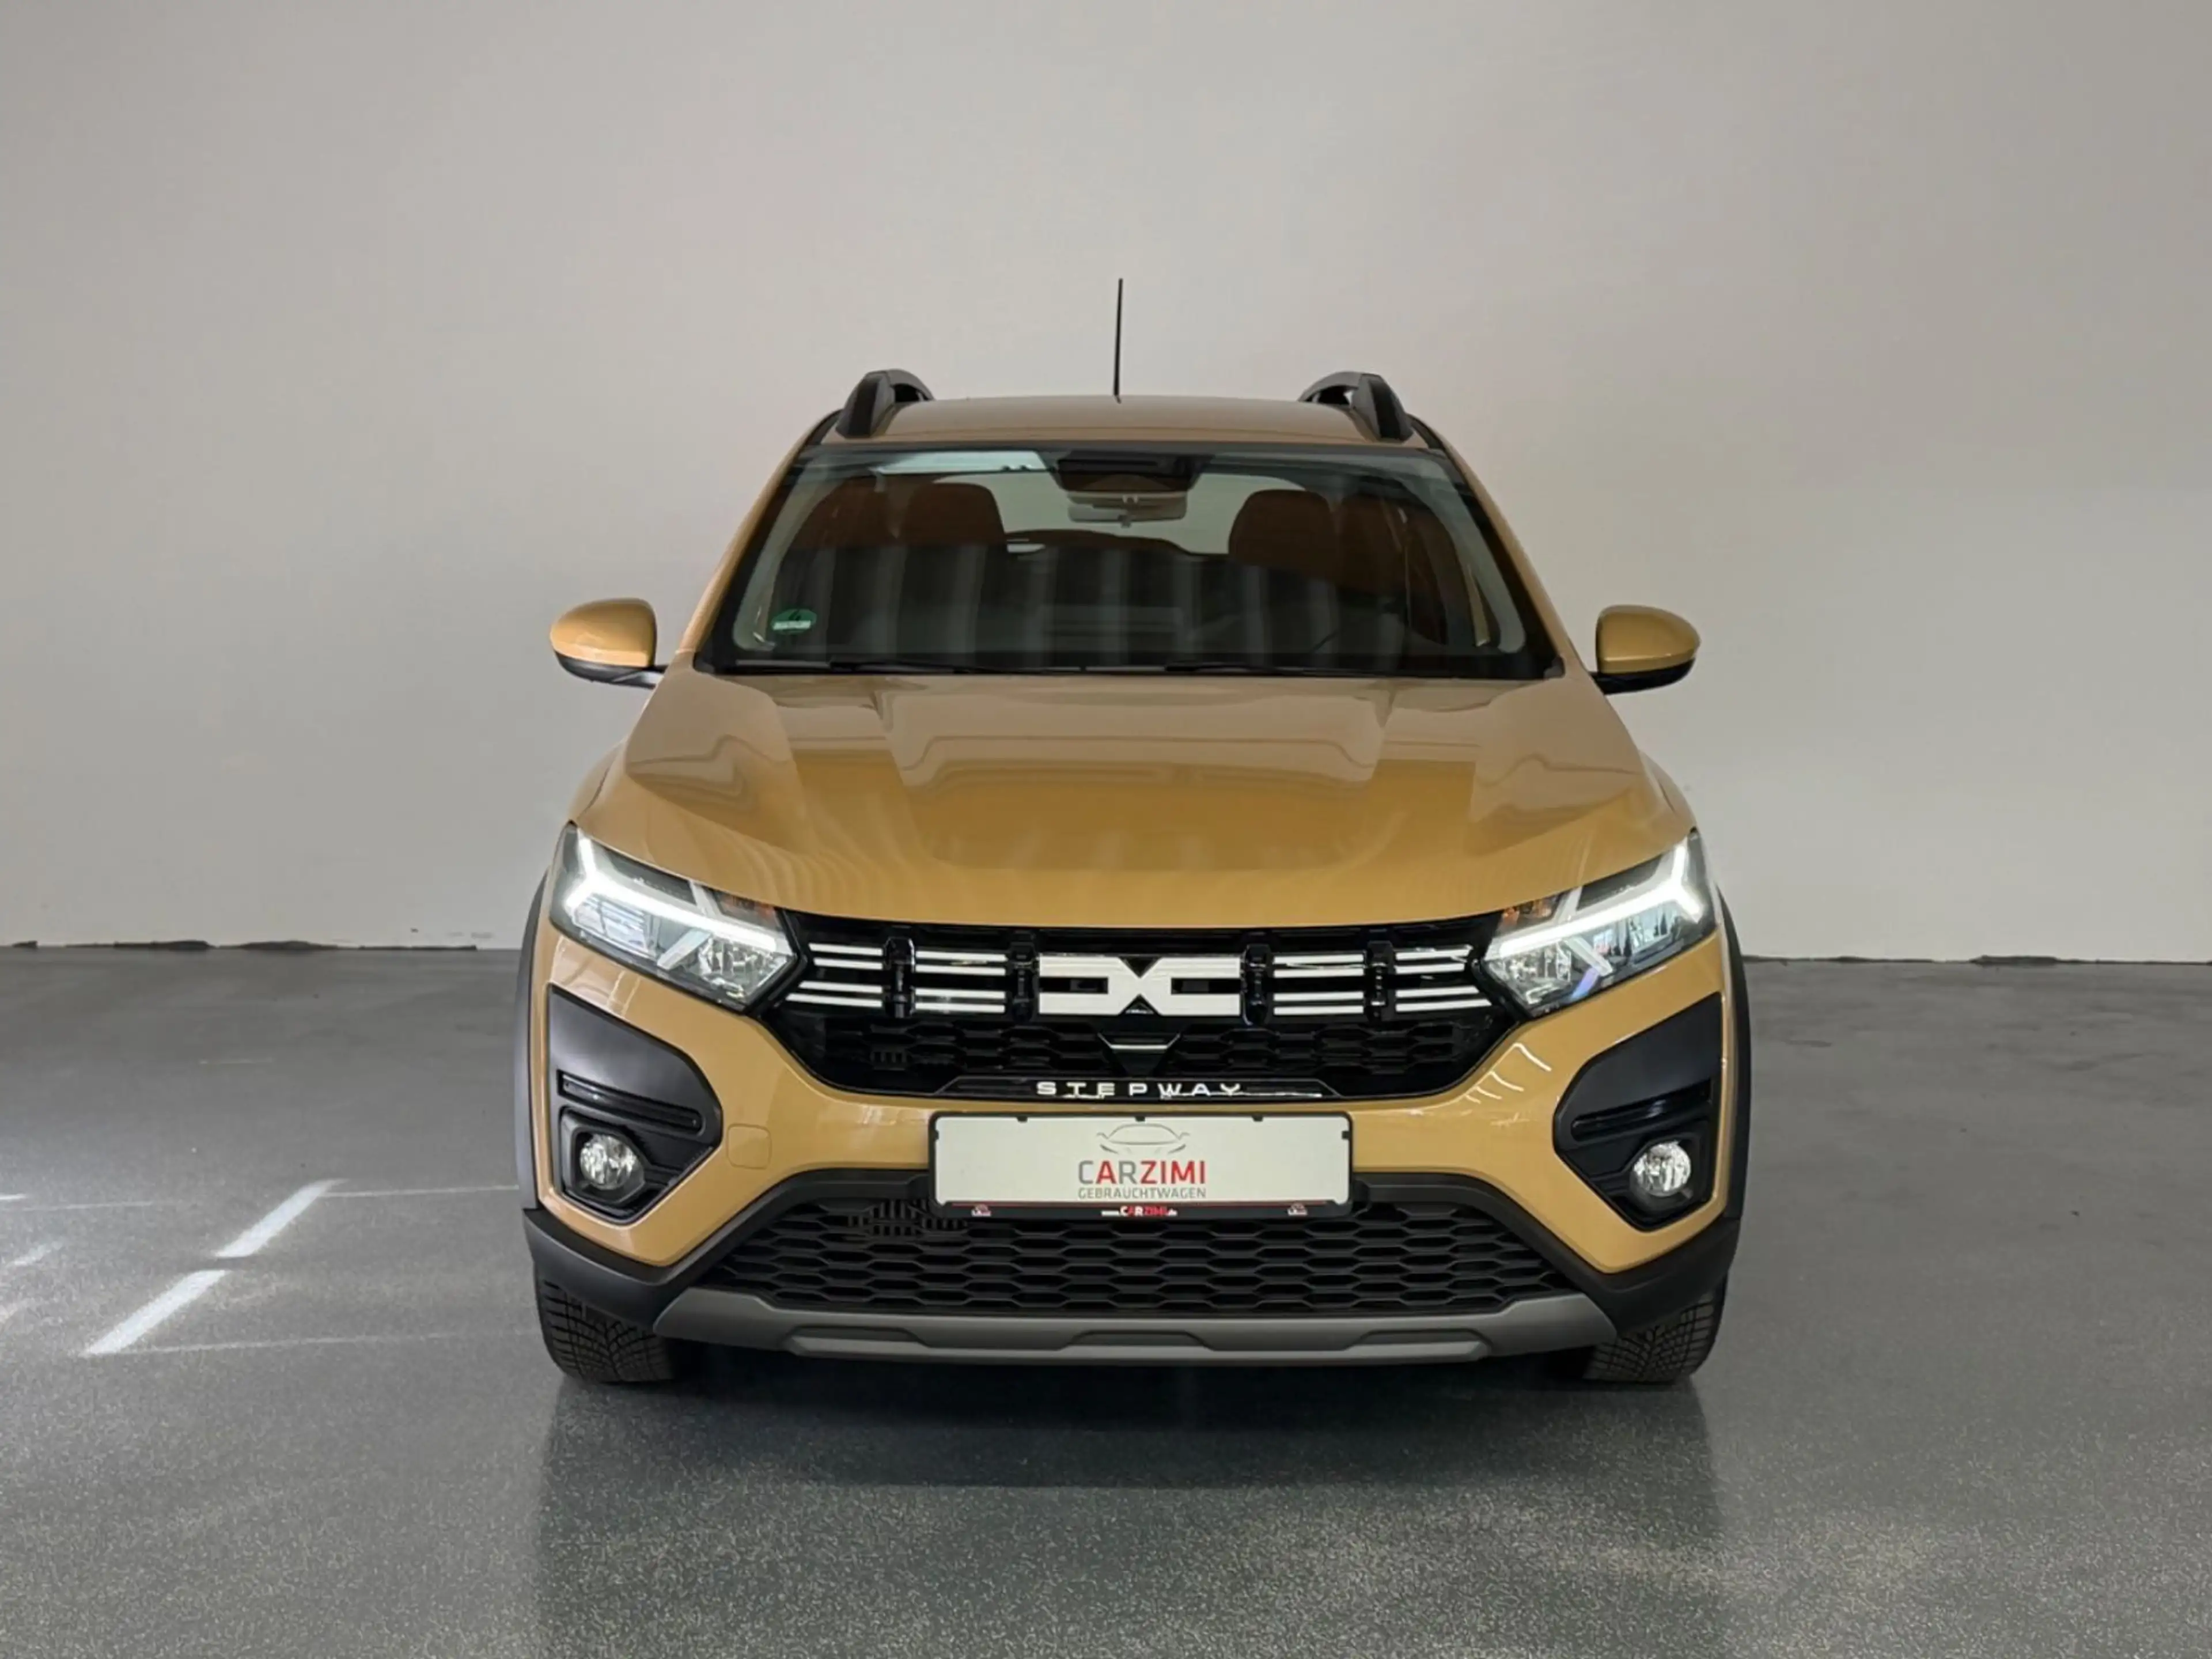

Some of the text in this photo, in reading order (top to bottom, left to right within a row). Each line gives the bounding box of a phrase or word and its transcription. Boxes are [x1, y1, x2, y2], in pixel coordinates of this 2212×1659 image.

[1036, 1081, 1240, 1096] STEPWAY
[1078, 1160, 1206, 1184] CARZIMI
[1078, 1187, 1206, 1199] GEBRAUCHTWAGEN
